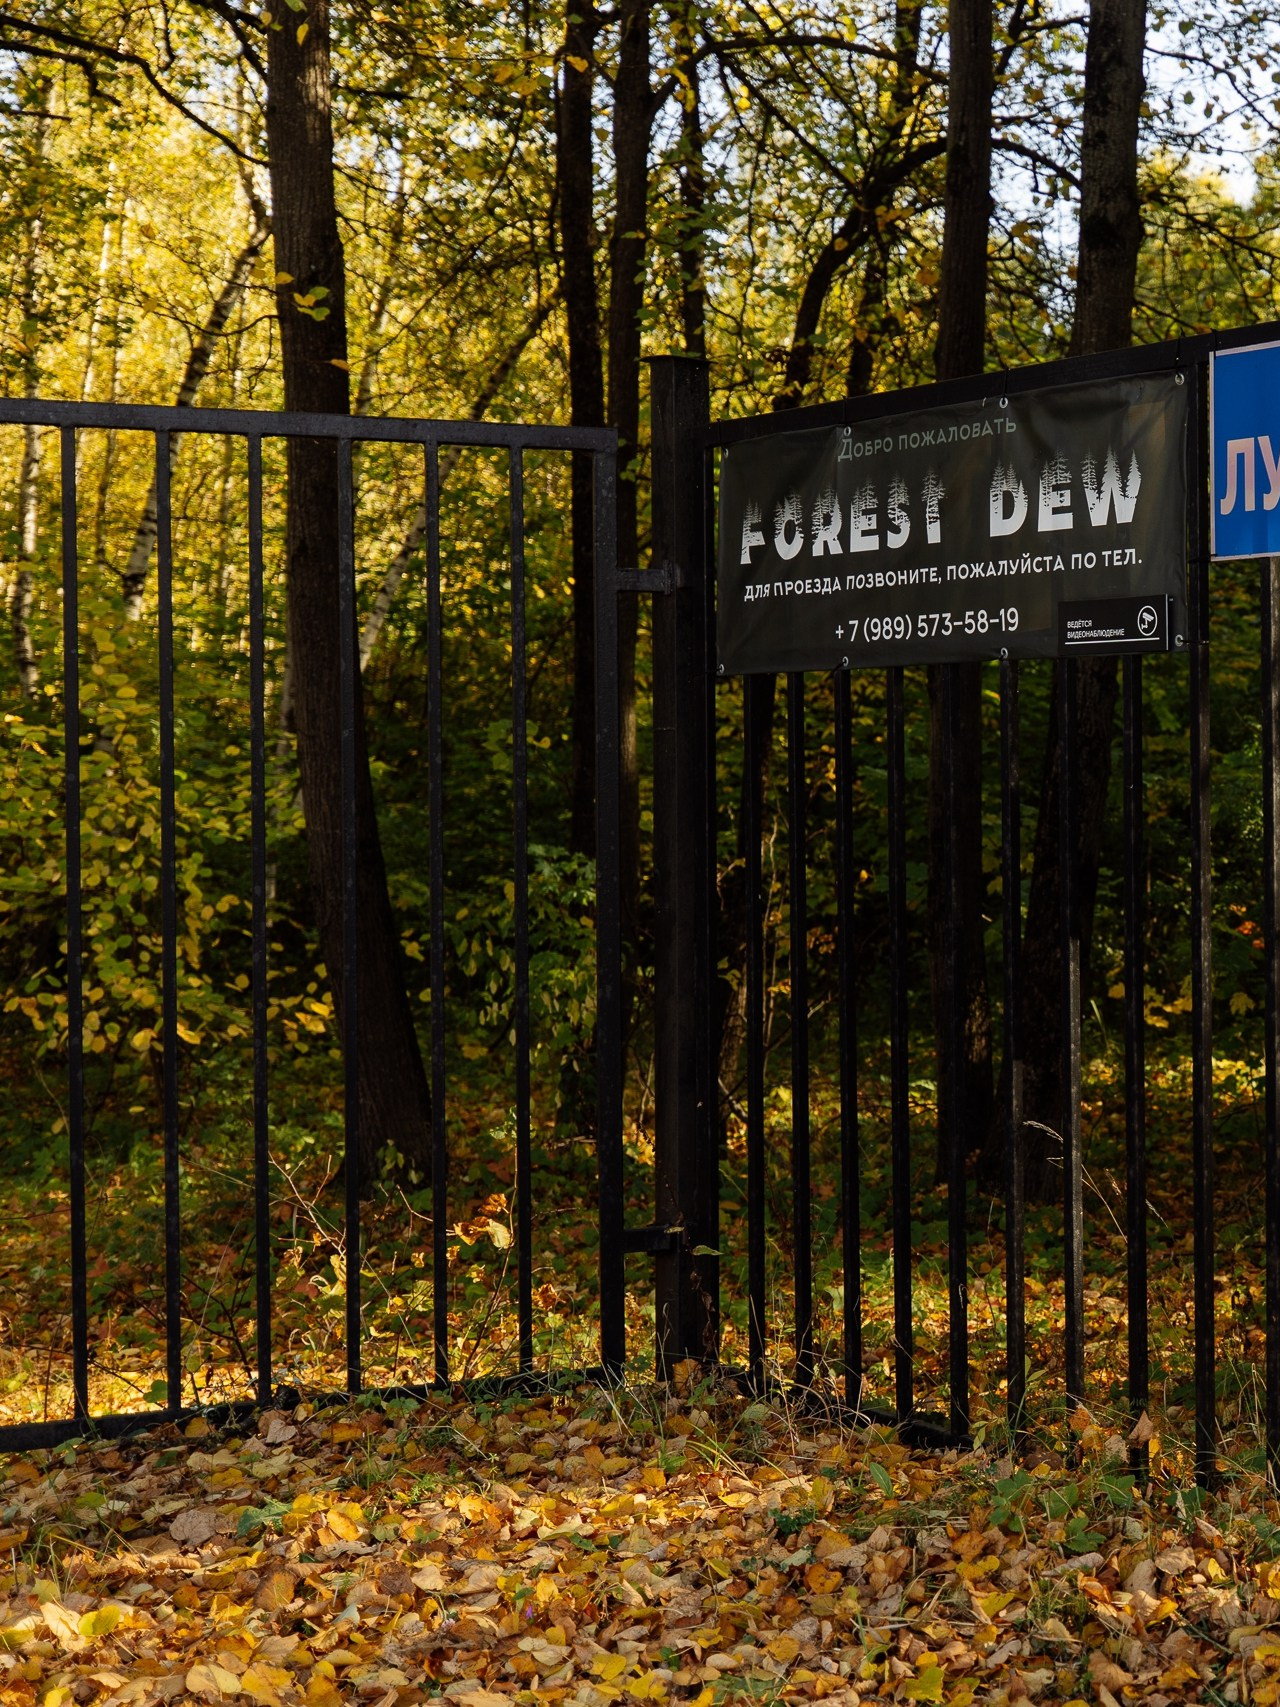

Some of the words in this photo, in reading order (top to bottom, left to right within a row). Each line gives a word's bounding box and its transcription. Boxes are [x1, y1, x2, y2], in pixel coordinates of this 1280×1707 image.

[740, 465, 948, 565] FOREST
[989, 445, 1142, 538] DEW
[744, 584, 770, 602] ДЛЯ
[774, 577, 842, 597] ПРОЕЗДА
[845, 566, 943, 592] ПОЗВОНИТЕ,
[946, 554, 1065, 582] ПОЖАЛУЙСТА
[1071, 551, 1097, 571] ПО
[1102, 548, 1143, 567] ТЕЛ.
[863, 614, 912, 644] (989)
[917, 607, 1019, 637] 573-58-19
[1067, 619, 1092, 628] ВЕДЁТСЯ
[1067, 628, 1124, 638] ВИДЕОНАБЛЮДЕНИЕ
